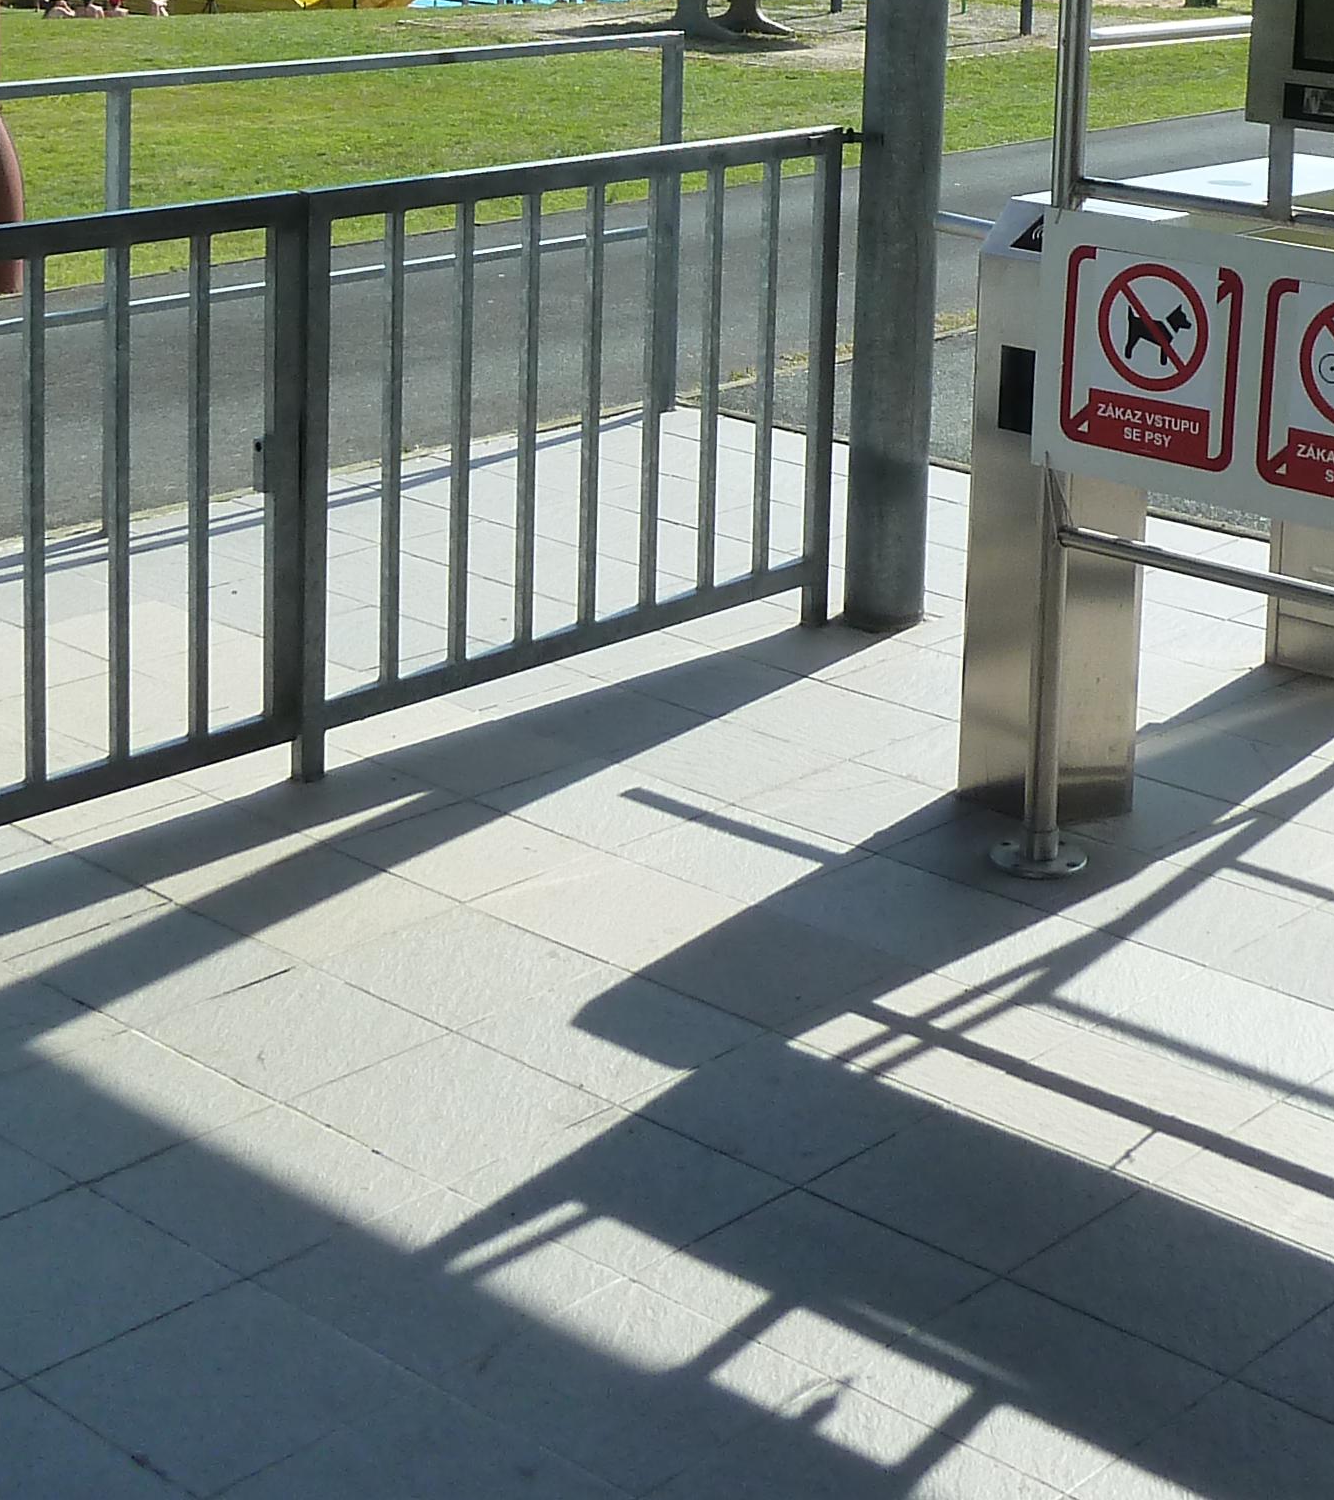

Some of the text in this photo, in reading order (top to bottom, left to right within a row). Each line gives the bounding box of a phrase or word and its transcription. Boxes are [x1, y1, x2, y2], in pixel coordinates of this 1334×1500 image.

[1096, 402, 1200, 435] ZÁKAZ VSTUPU
[1123, 426, 1172, 448] SE PSY
[1325, 469, 1334, 483] S
